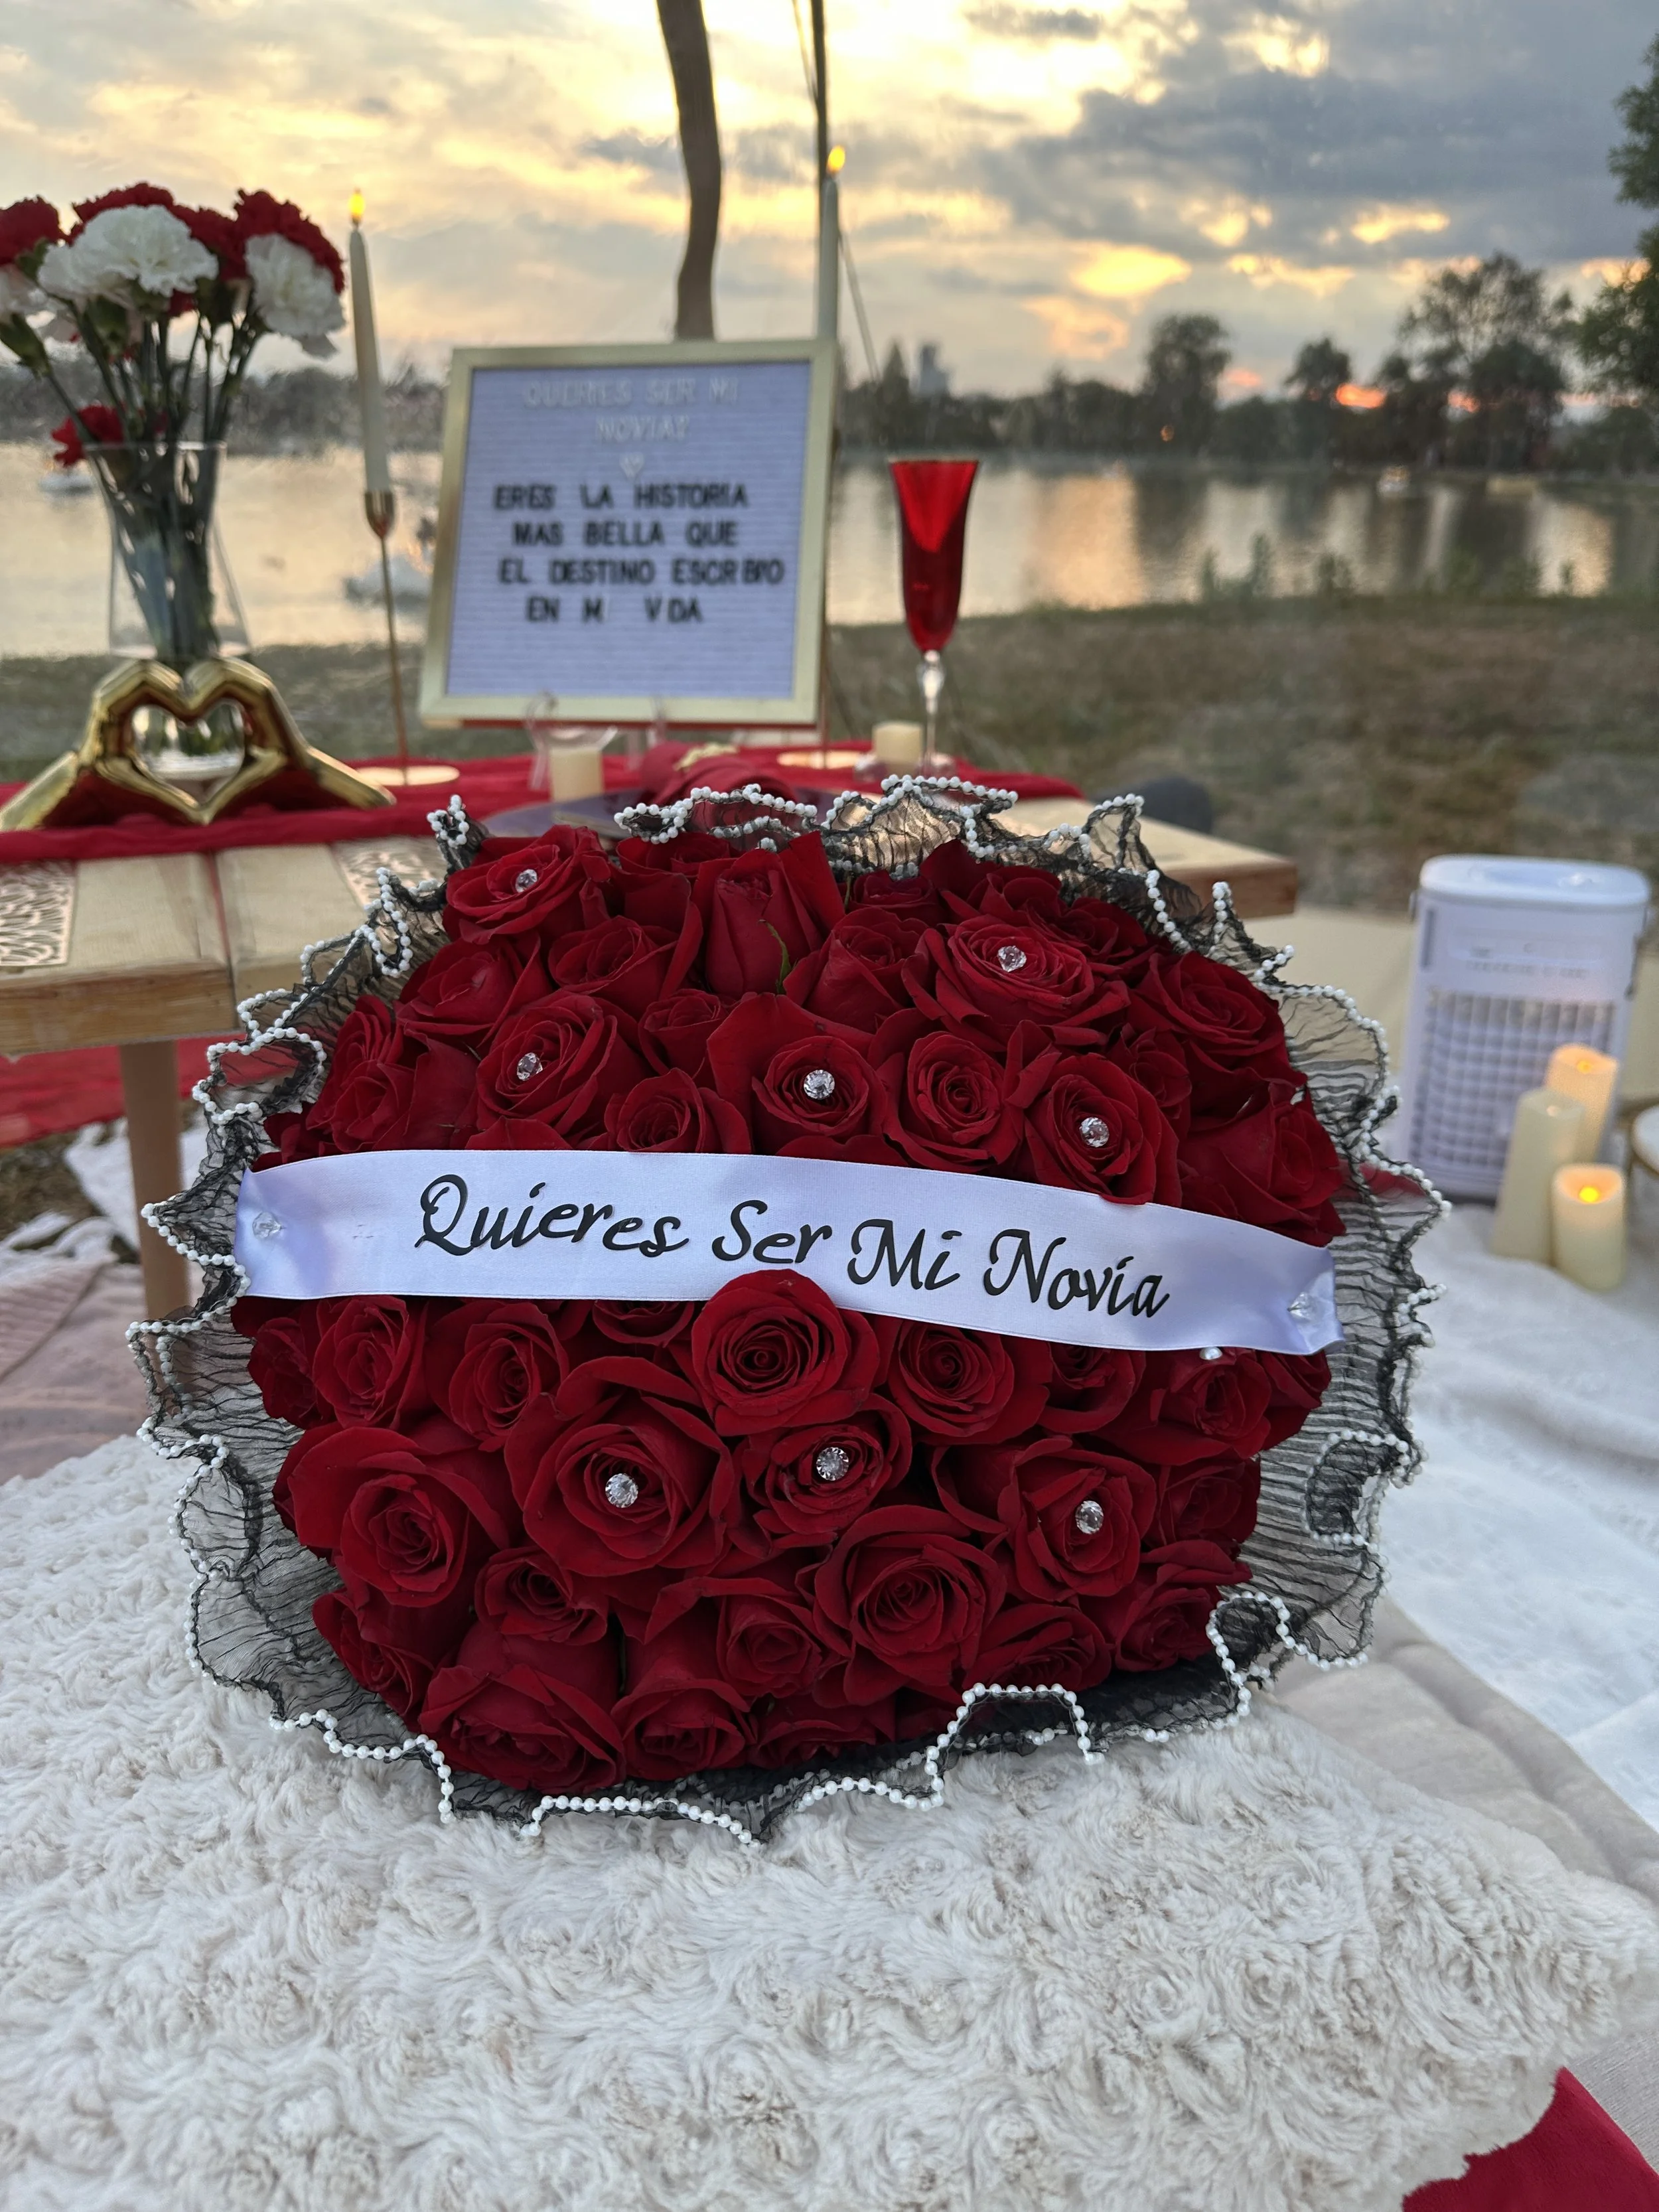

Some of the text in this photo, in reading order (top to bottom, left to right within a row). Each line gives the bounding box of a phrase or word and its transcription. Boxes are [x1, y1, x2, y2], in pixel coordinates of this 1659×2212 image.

[524, 378, 632, 407] QUIERES
[646, 378, 695, 406] SER
[494, 483, 749, 510] ERES LA HISTORIA
[512, 520, 740, 546] MAS BELLA QUE
[498, 558, 530, 584] EL
[549, 558, 656, 585] DESTINO
[526, 596, 560, 622] EN
[414, 1174, 1171, 1319] Quieres Ser Mi Novia
